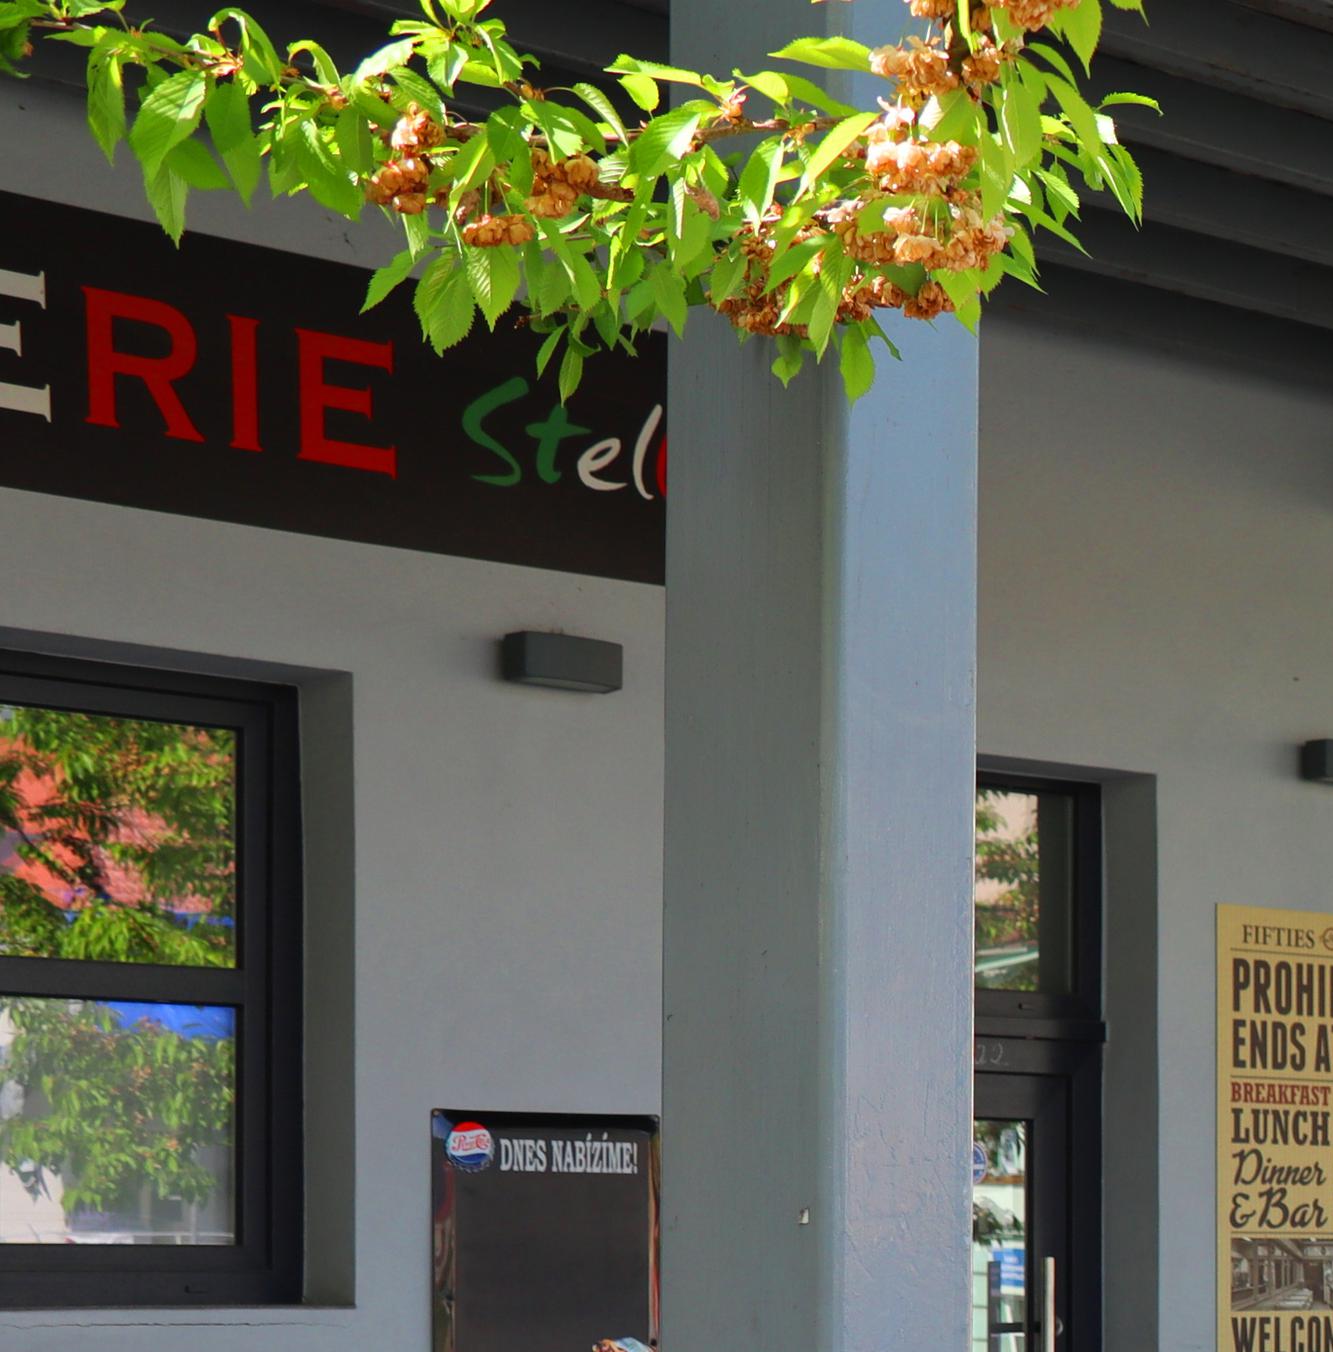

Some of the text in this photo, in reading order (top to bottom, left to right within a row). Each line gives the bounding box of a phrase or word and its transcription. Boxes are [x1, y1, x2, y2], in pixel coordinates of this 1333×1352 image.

[461, 375, 668, 500] Stel
[1242, 924, 1316, 948] FIFTIES
[1232, 1019, 1306, 1072] ENDS
[1230, 1081, 1331, 1106] BREAKFAST
[1231, 1108, 1330, 1147] LUNCH
[499, 1131, 638, 1175] DNES NABÍZÍME!
[1231, 1149, 1326, 1187] Dinner
[1229, 1187, 1328, 1229] & Bar
